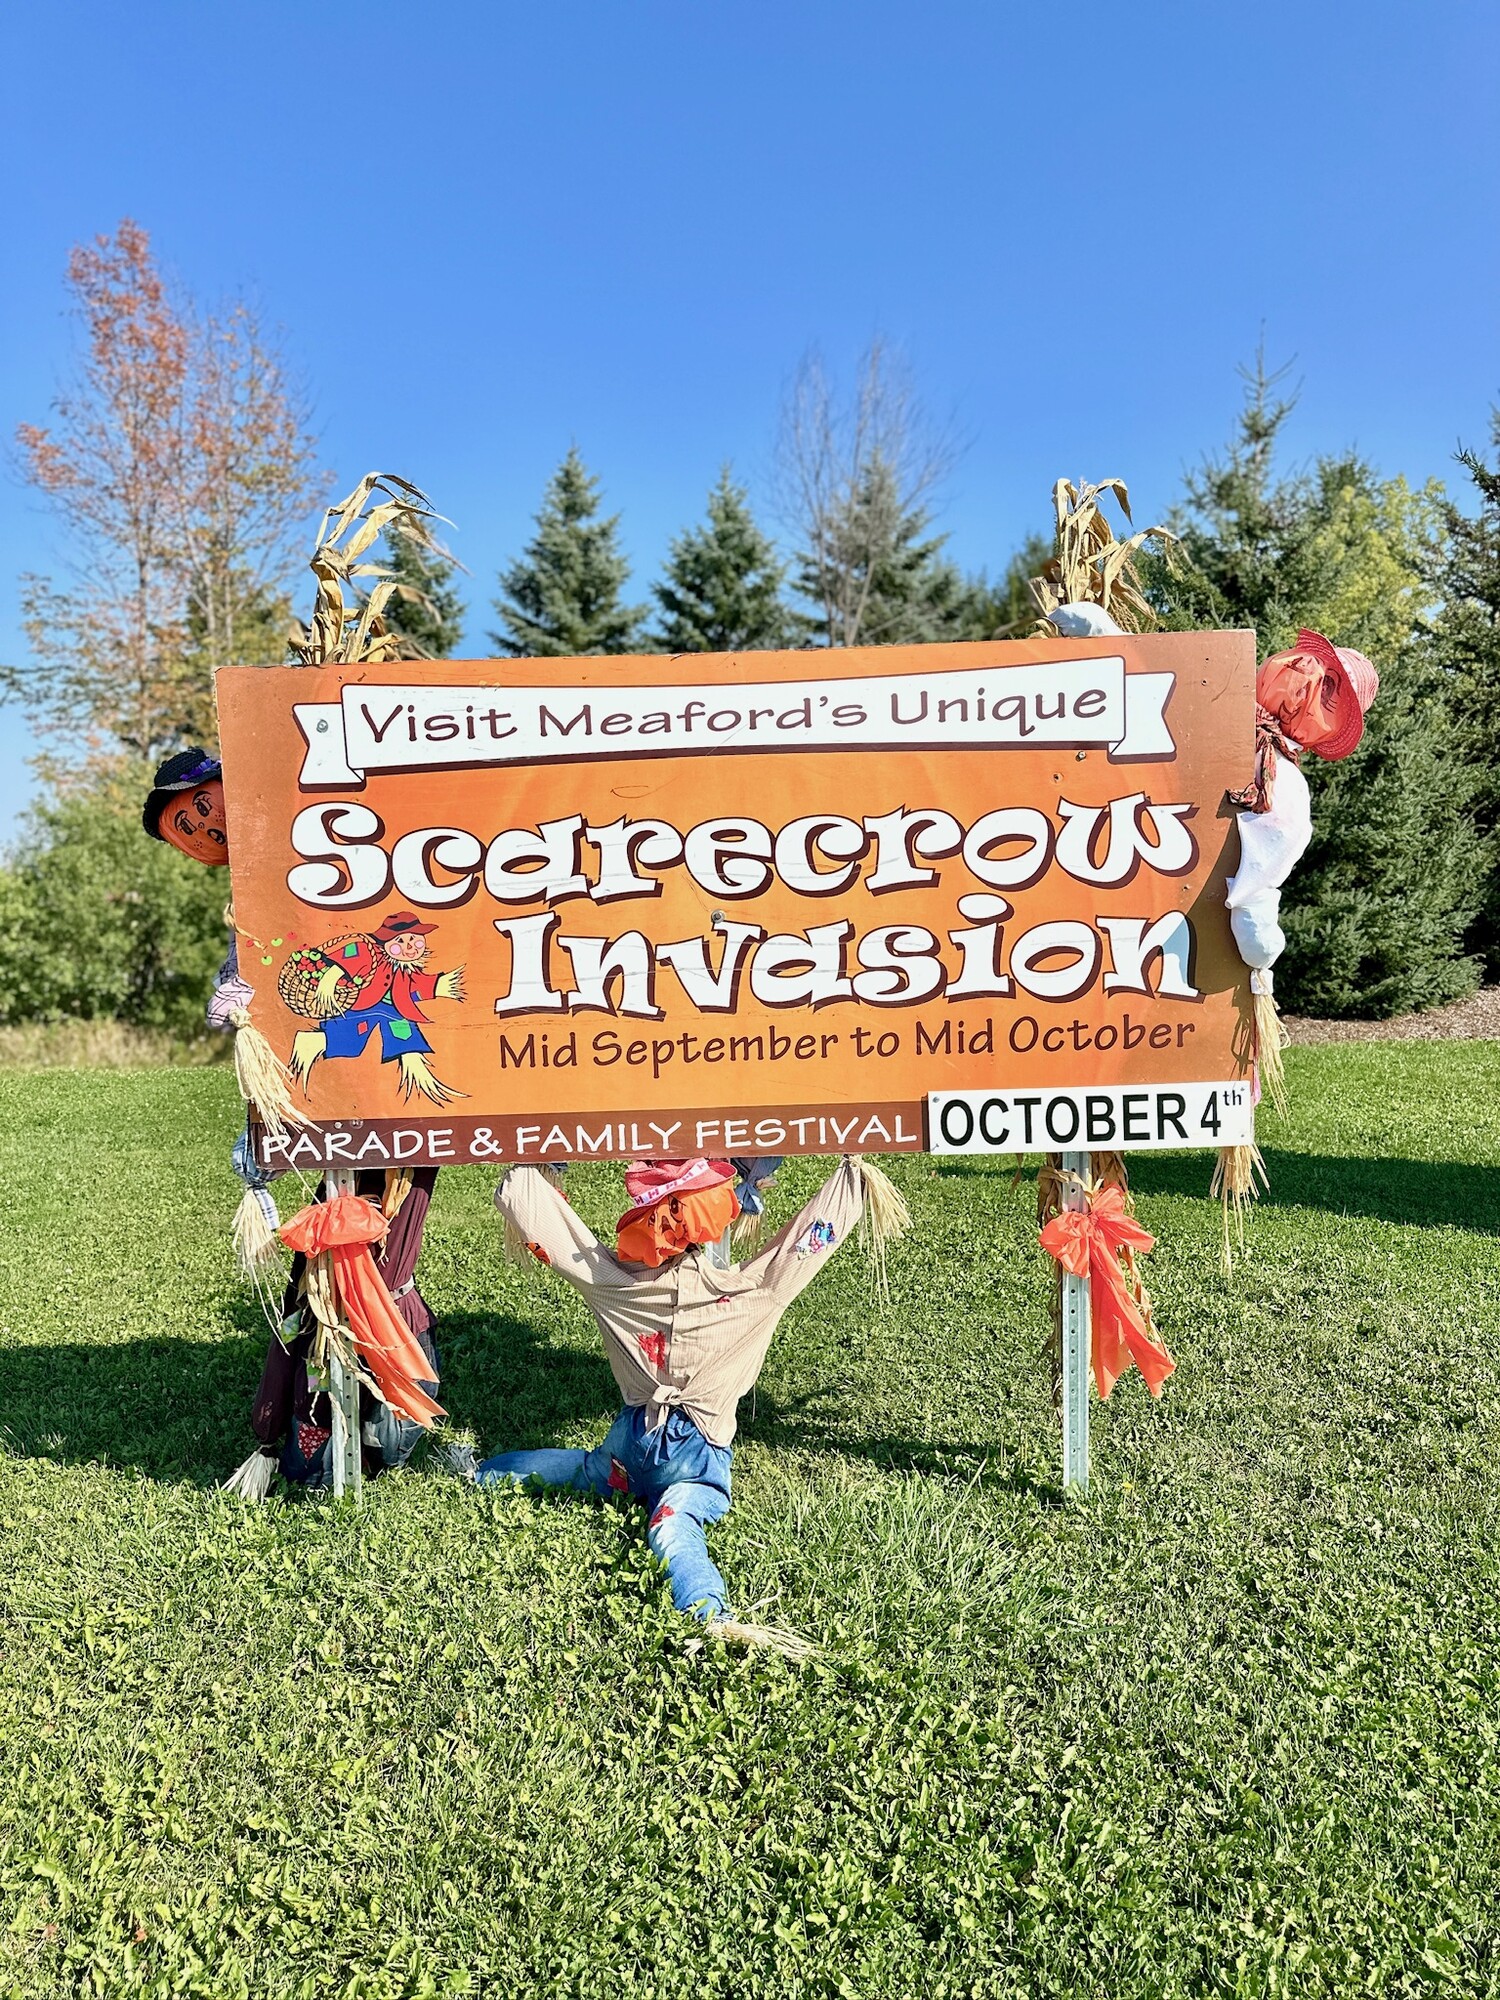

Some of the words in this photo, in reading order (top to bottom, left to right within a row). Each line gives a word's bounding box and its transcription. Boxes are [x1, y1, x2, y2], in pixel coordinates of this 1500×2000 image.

[360, 703, 518, 742] Visit
[539, 695, 868, 738] Meaford’s
[890, 687, 1108, 737] Unique
[285, 790, 1199, 911] Scarecrow
[492, 892, 1206, 1022] Invasion
[499, 1032, 578, 1069] Mid
[592, 1024, 839, 1079] September
[850, 1027, 901, 1059] to
[915, 1018, 995, 1056] Mid
[1009, 1013, 1196, 1051] October
[262, 1127, 455, 1163] PARADE
[469, 1126, 501, 1155] &
[516, 1121, 683, 1155] FAMILY
[695, 1114, 917, 1150] FESTIVAL
[939, 1092, 1188, 1147] OCTOBER
[1200, 1089, 1243, 1137] 4th
